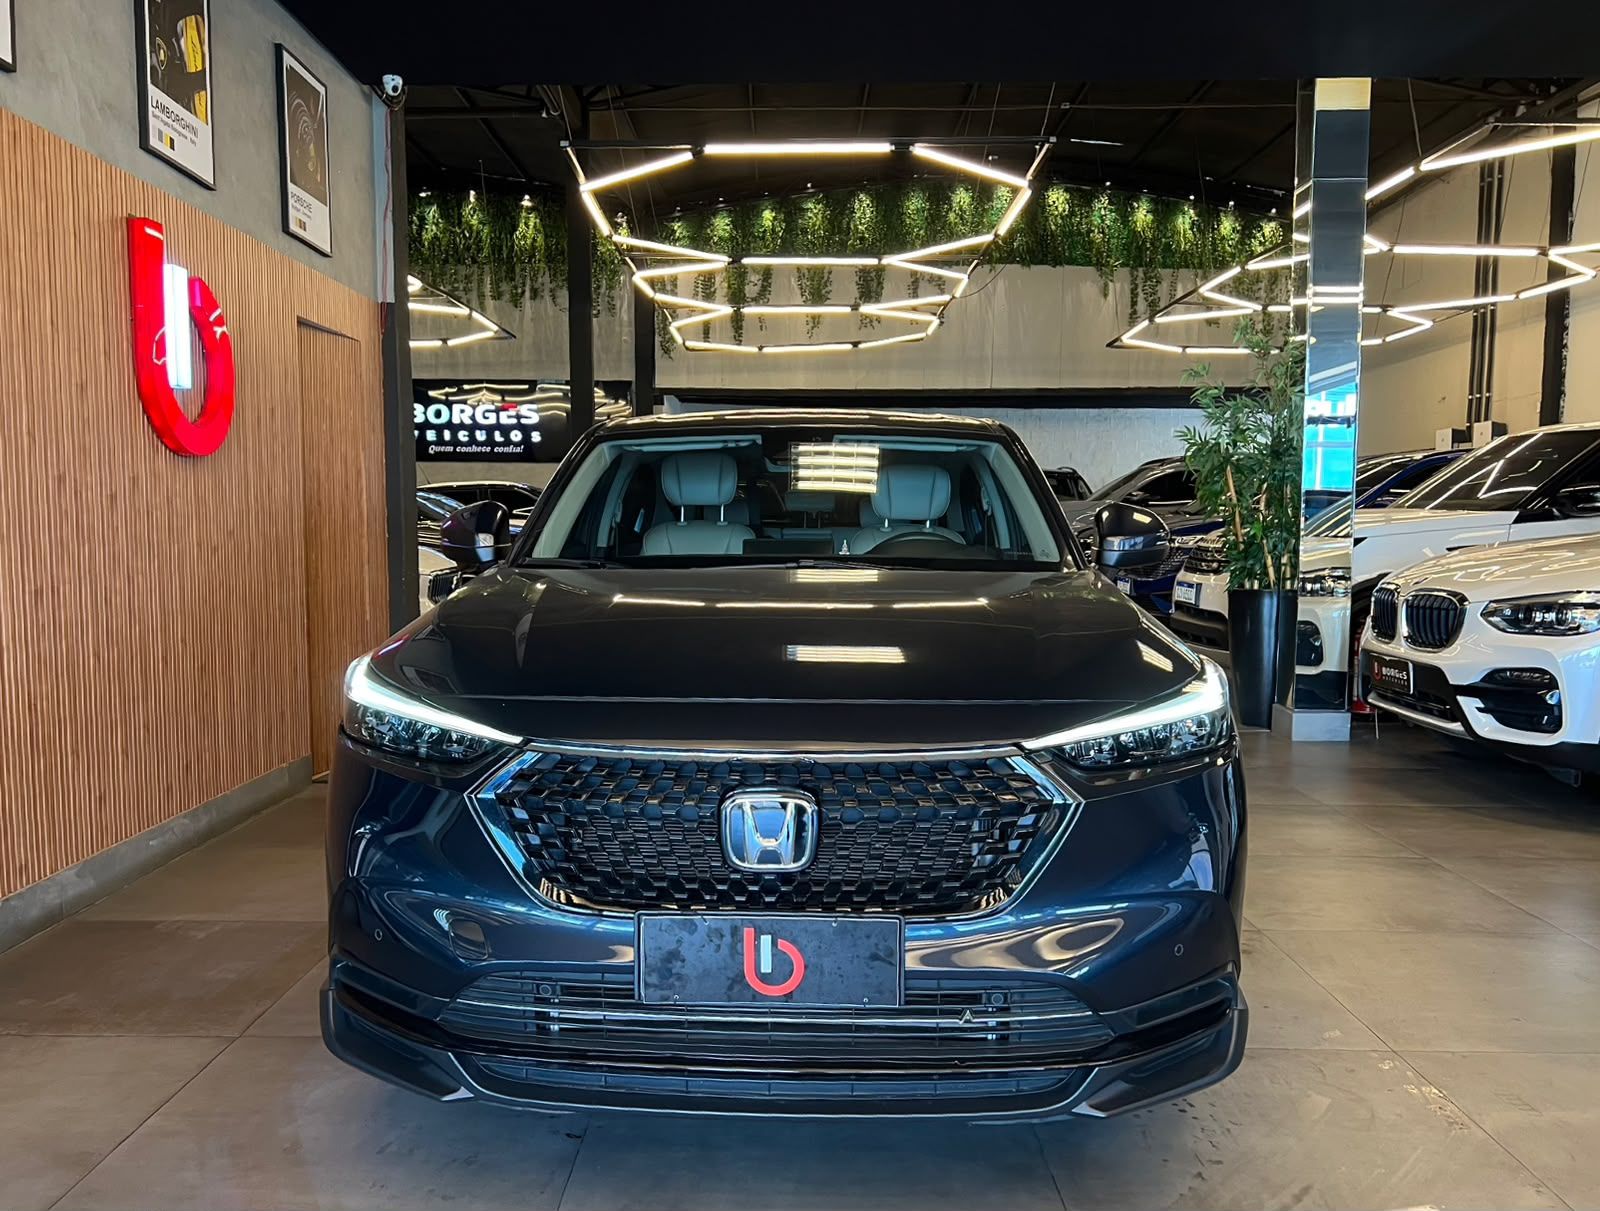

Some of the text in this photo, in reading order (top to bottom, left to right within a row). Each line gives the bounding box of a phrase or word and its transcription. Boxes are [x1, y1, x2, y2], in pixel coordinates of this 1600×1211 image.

[150, 95, 199, 139] LAMBORGHINI
[413, 403, 540, 425] BORGES
[428, 444, 524, 454] Quem conhece confia!
